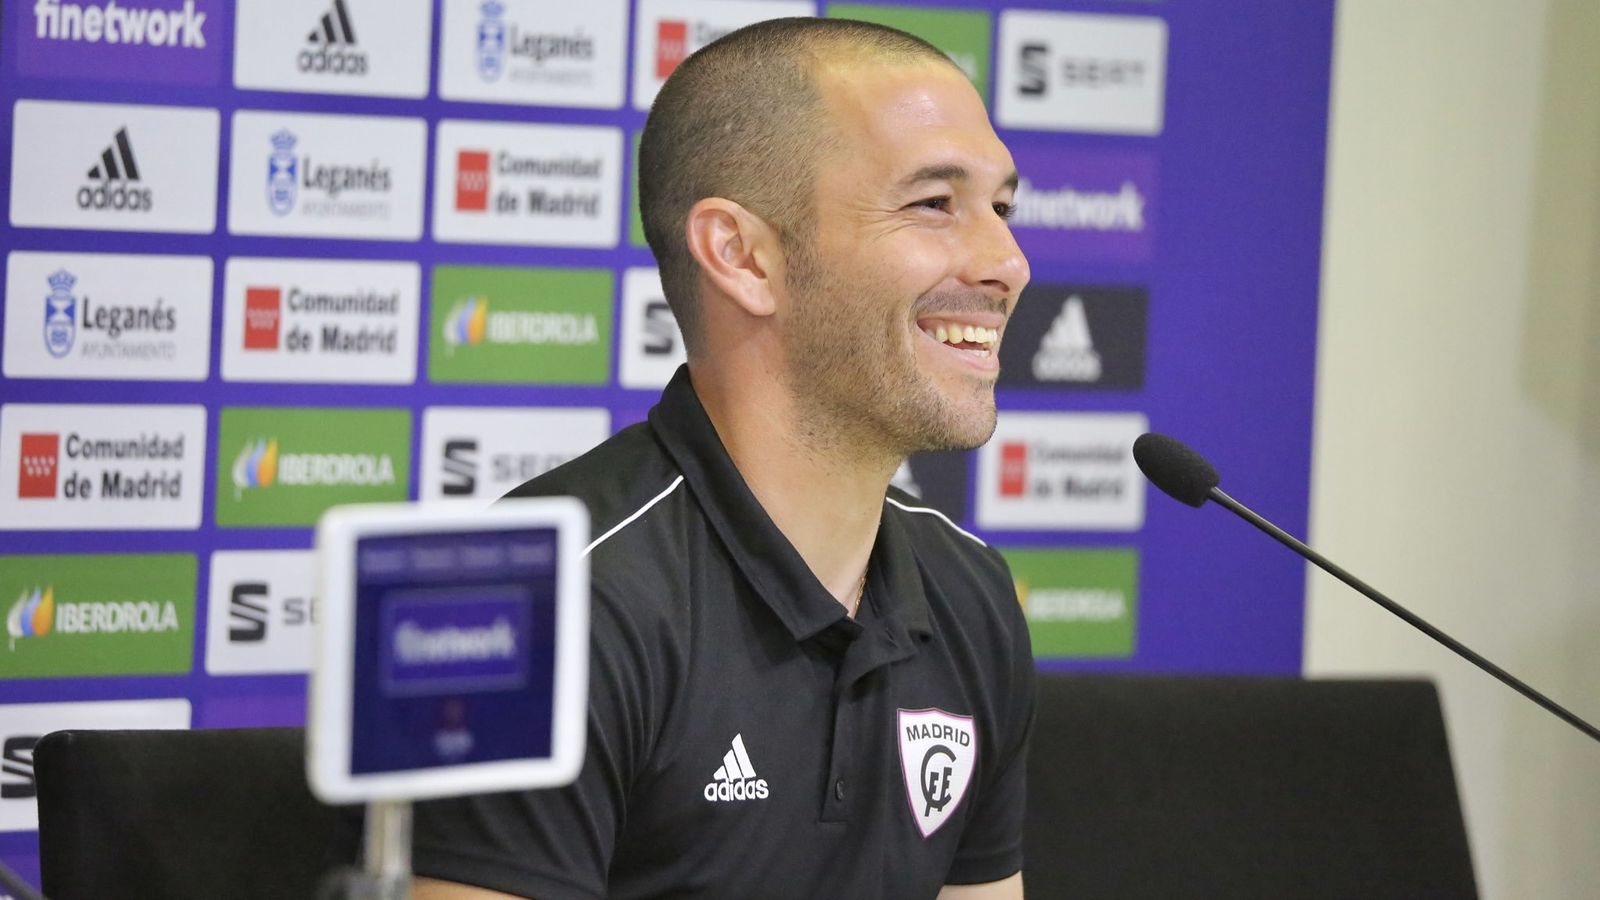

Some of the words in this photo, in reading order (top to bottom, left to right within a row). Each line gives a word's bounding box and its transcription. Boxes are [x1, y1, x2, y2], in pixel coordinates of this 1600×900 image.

[34, 0, 207, 49] finetwork
[511, 25, 594, 65] Leganés
[297, 48, 369, 75] adidas
[302, 156, 391, 196] Leganés
[495, 150, 604, 180] Comunidad
[77, 183, 153, 212] adidas
[495, 188, 519, 212] de
[527, 189, 600, 217] Madrid
[287, 288, 400, 316] Comunidad
[81, 299, 177, 338] Leganés
[285, 326, 313, 351] de
[320, 327, 398, 354] Madrid
[65, 433, 184, 460] Comunidad
[279, 453, 395, 486] IBERDROLA
[63, 472, 91, 499] de
[101, 472, 181, 499] Madrid
[56, 600, 179, 634] IBERDROLA
[906, 723, 970, 748] MADRID
[703, 776, 769, 802] adidas
